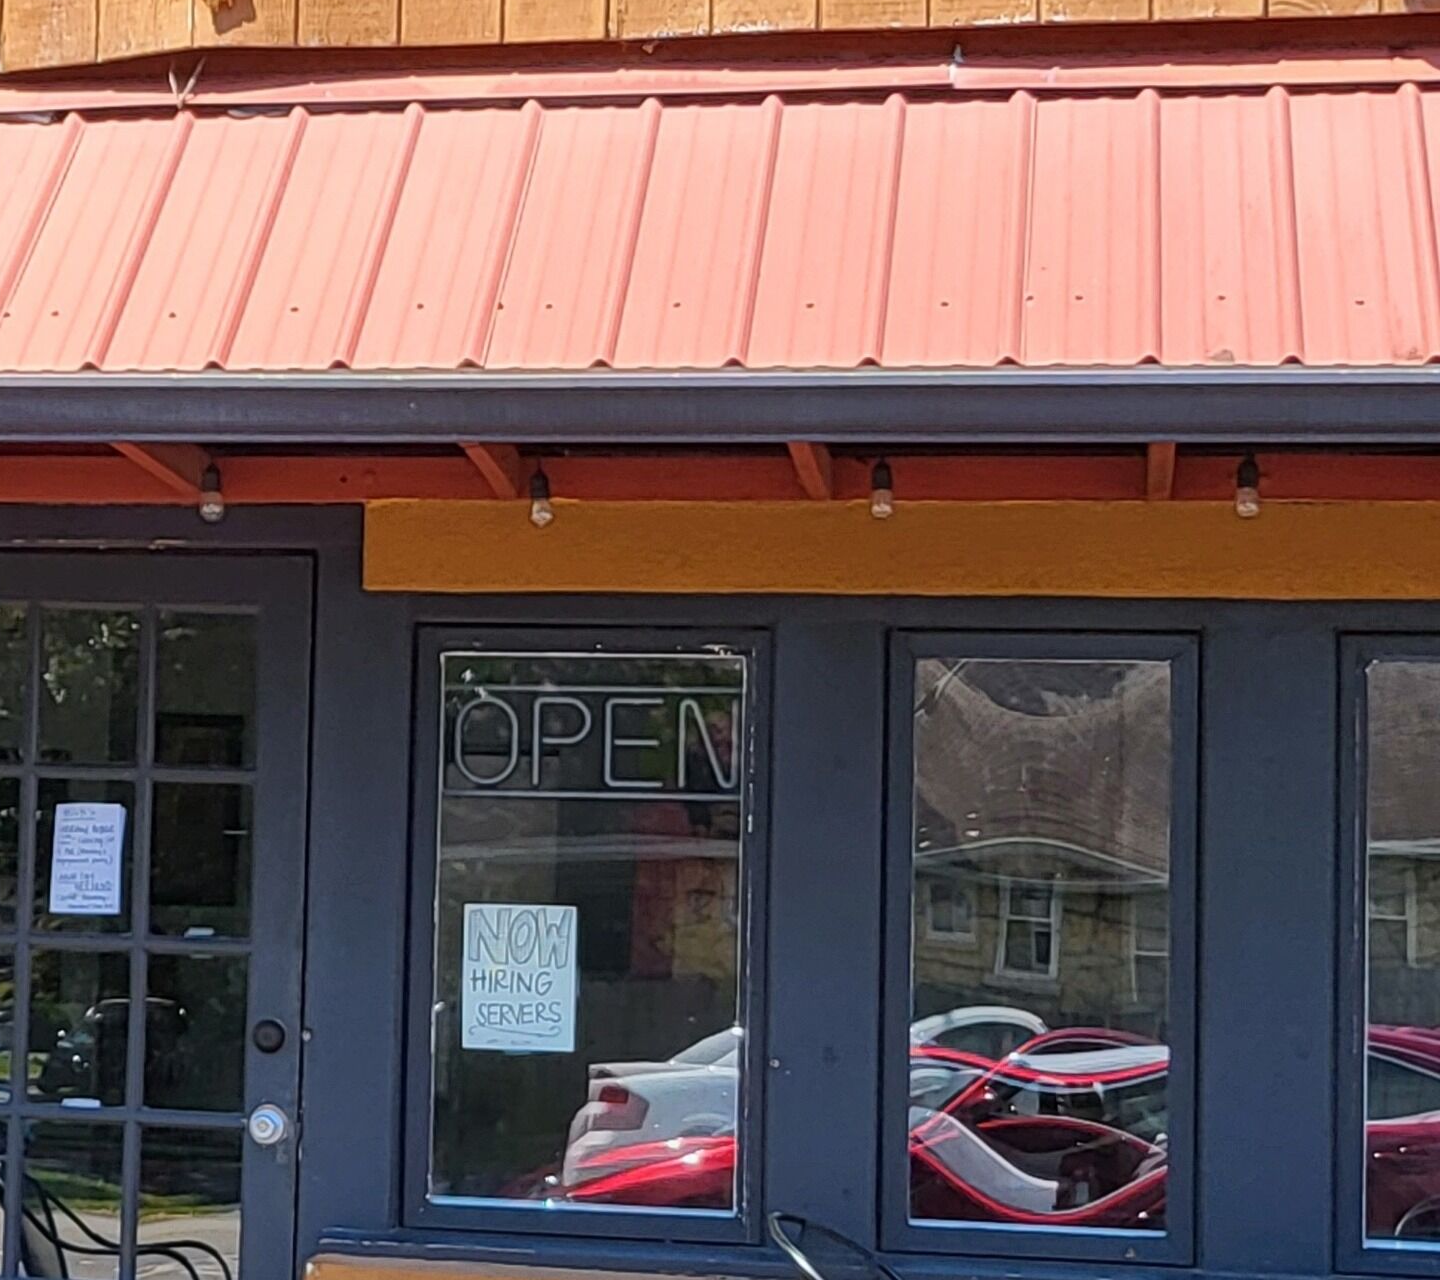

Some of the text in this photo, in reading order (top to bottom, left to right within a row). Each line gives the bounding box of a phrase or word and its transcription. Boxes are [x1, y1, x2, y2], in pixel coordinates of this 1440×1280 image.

[454, 694, 740, 791] OPEN
[468, 907, 574, 969] NOW
[470, 967, 553, 997] HIRING
[476, 1001, 562, 1027] SERVERS
